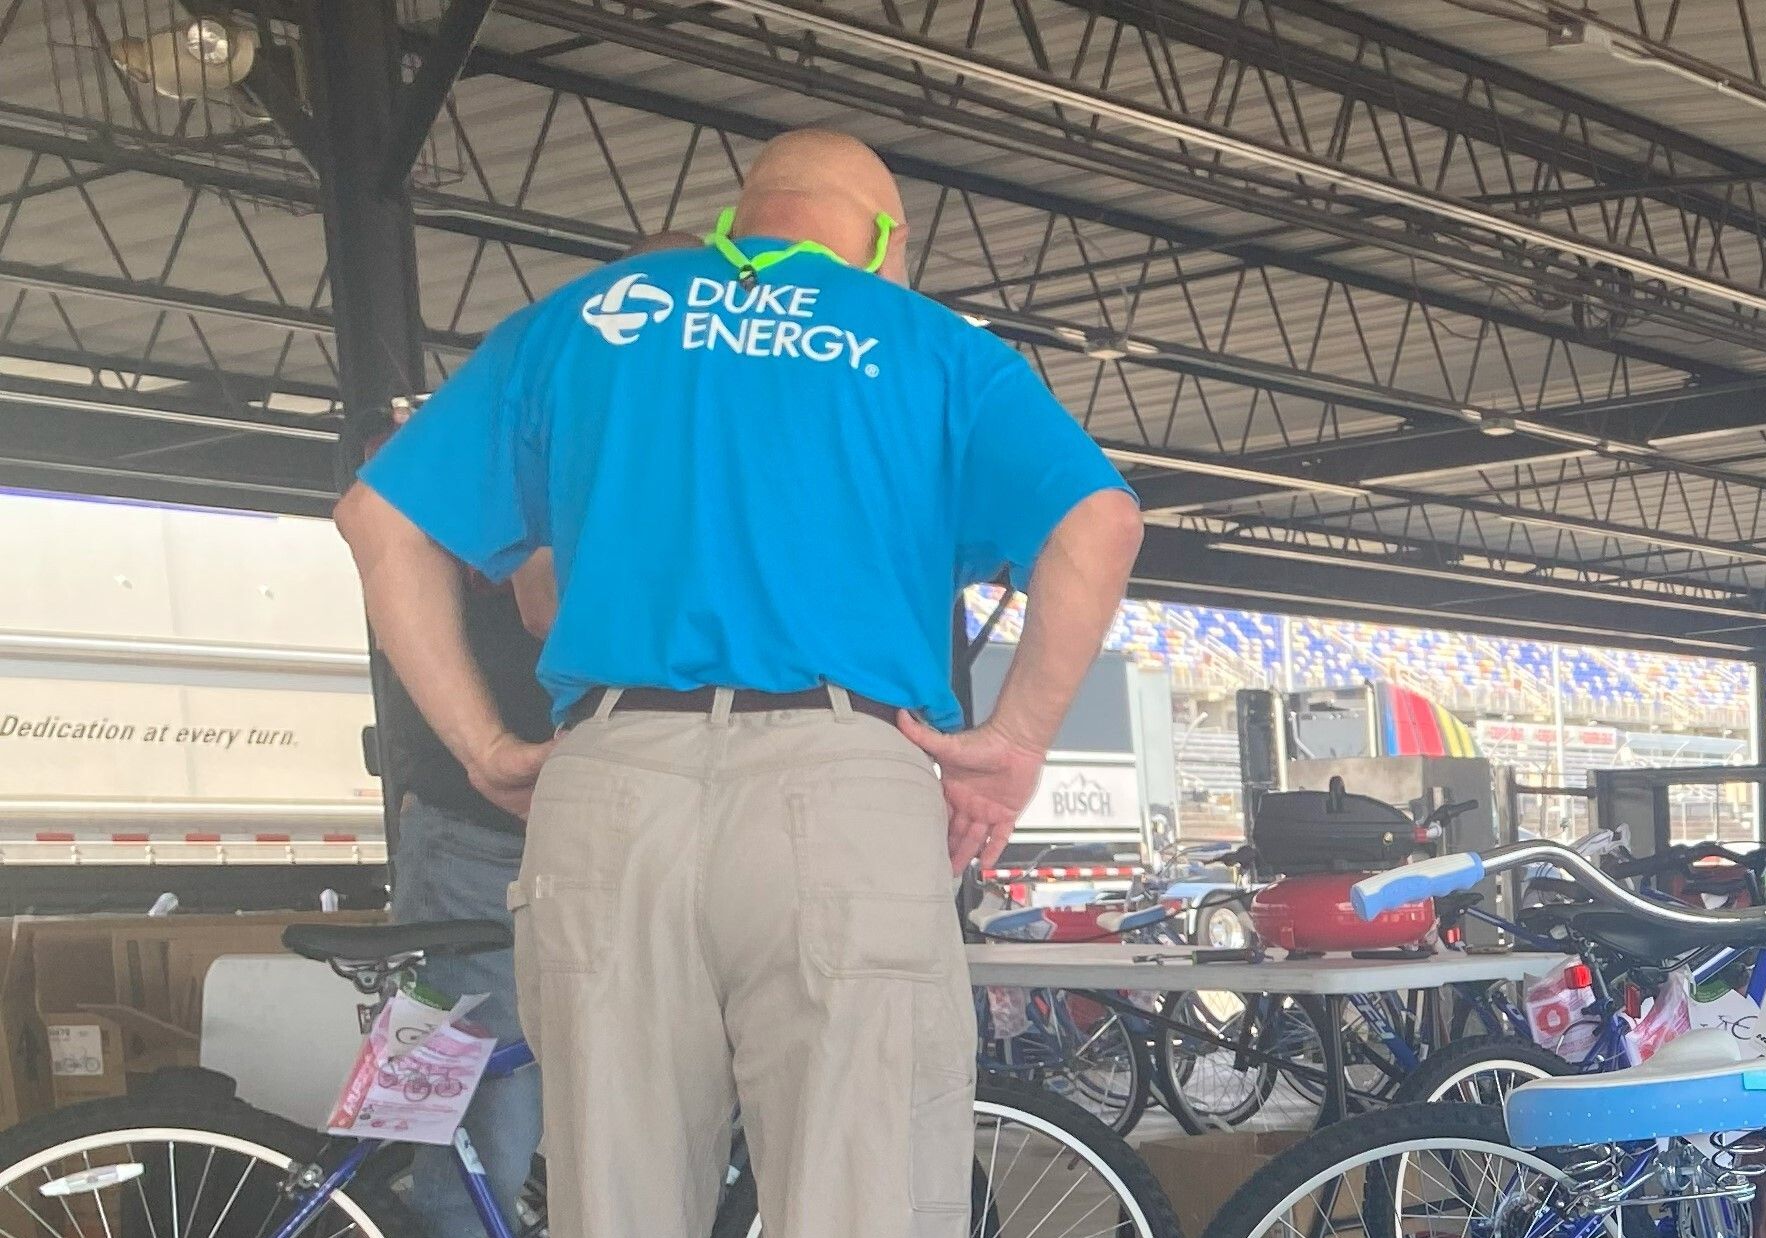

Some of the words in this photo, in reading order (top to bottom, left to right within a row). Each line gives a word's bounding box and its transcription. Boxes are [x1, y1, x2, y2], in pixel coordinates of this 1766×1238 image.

[686, 276, 822, 319] DUKE
[0, 715, 136, 741] Dedication
[143, 723, 171, 743] at
[175, 726, 241, 750] every
[246, 727, 301, 746] turn.
[1052, 791, 1112, 816] BUSCH
